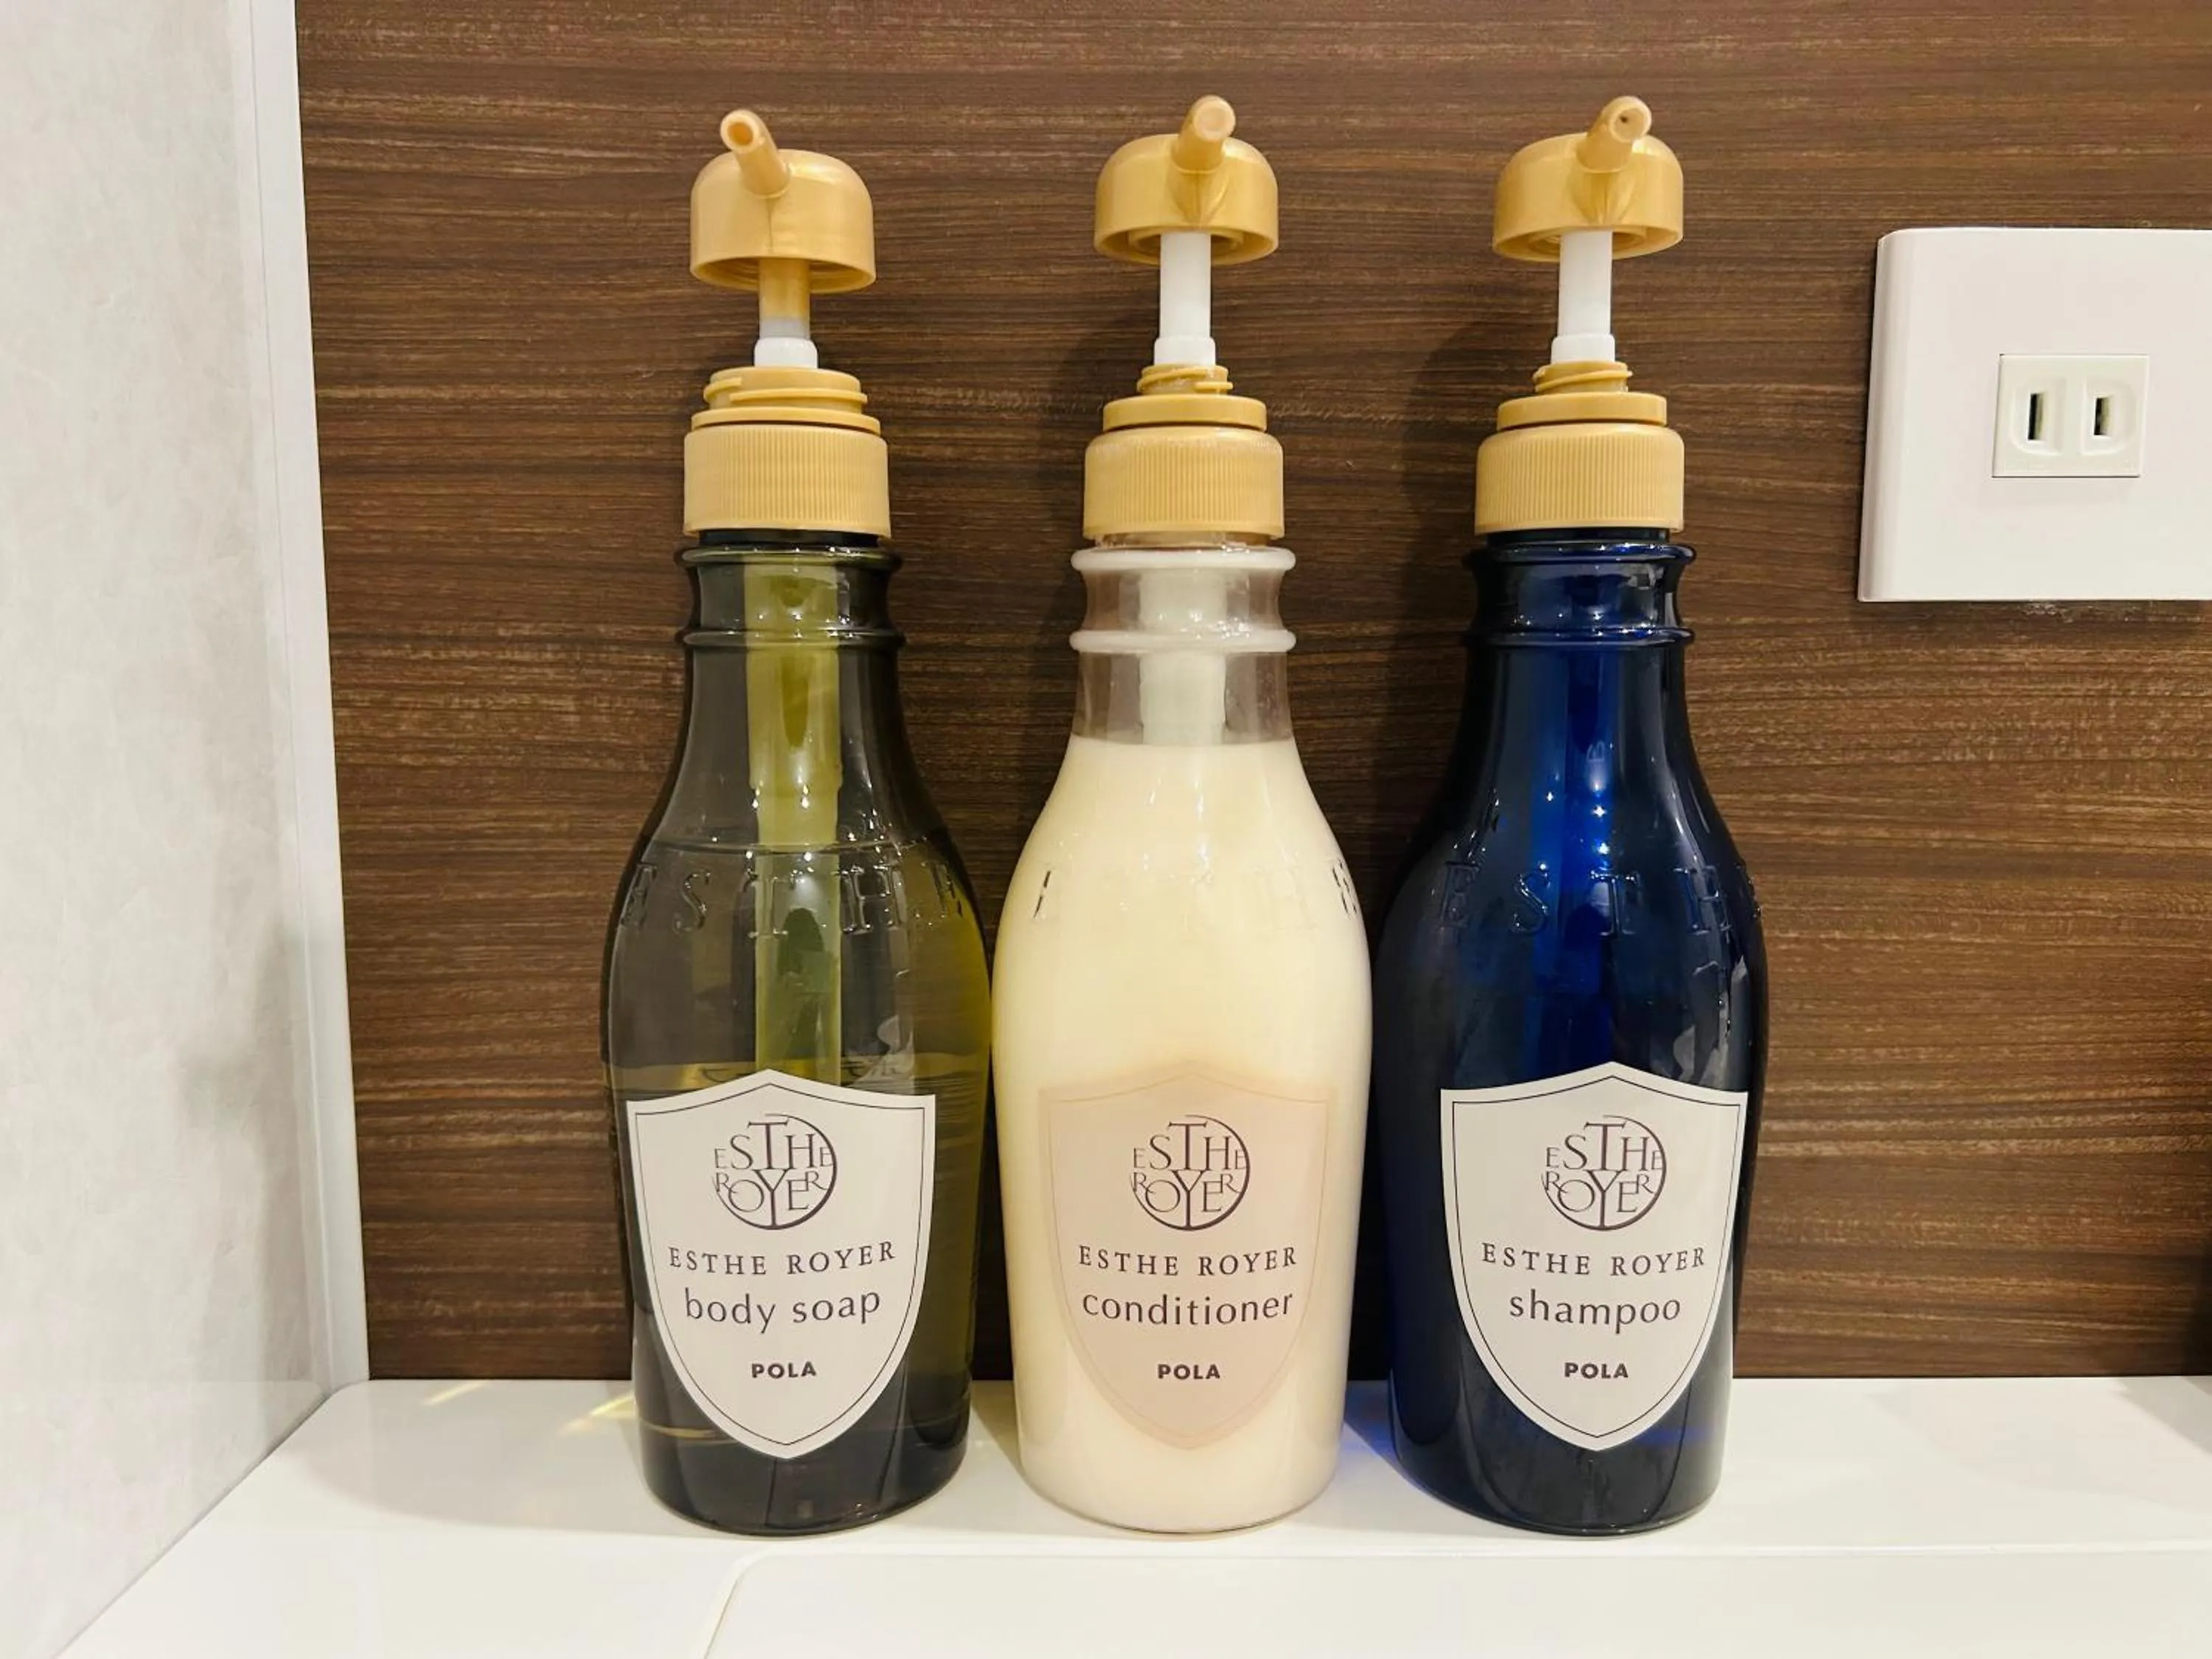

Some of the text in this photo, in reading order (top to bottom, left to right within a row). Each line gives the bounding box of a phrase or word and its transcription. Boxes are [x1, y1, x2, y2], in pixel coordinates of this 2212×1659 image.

[668, 1240, 896, 1276] ESTHE ROYER
[1078, 1244, 1298, 1277] ESTHE ROYER
[1481, 1242, 1705, 1277] ESTHE ROYER
[684, 1287, 881, 1335] body soap
[1082, 1293, 1294, 1326] conditioner
[1509, 1288, 1681, 1335] shampoo
[751, 1360, 818, 1380] POLA
[1157, 1363, 1222, 1381] POLA
[1563, 1361, 1630, 1380] POLA
